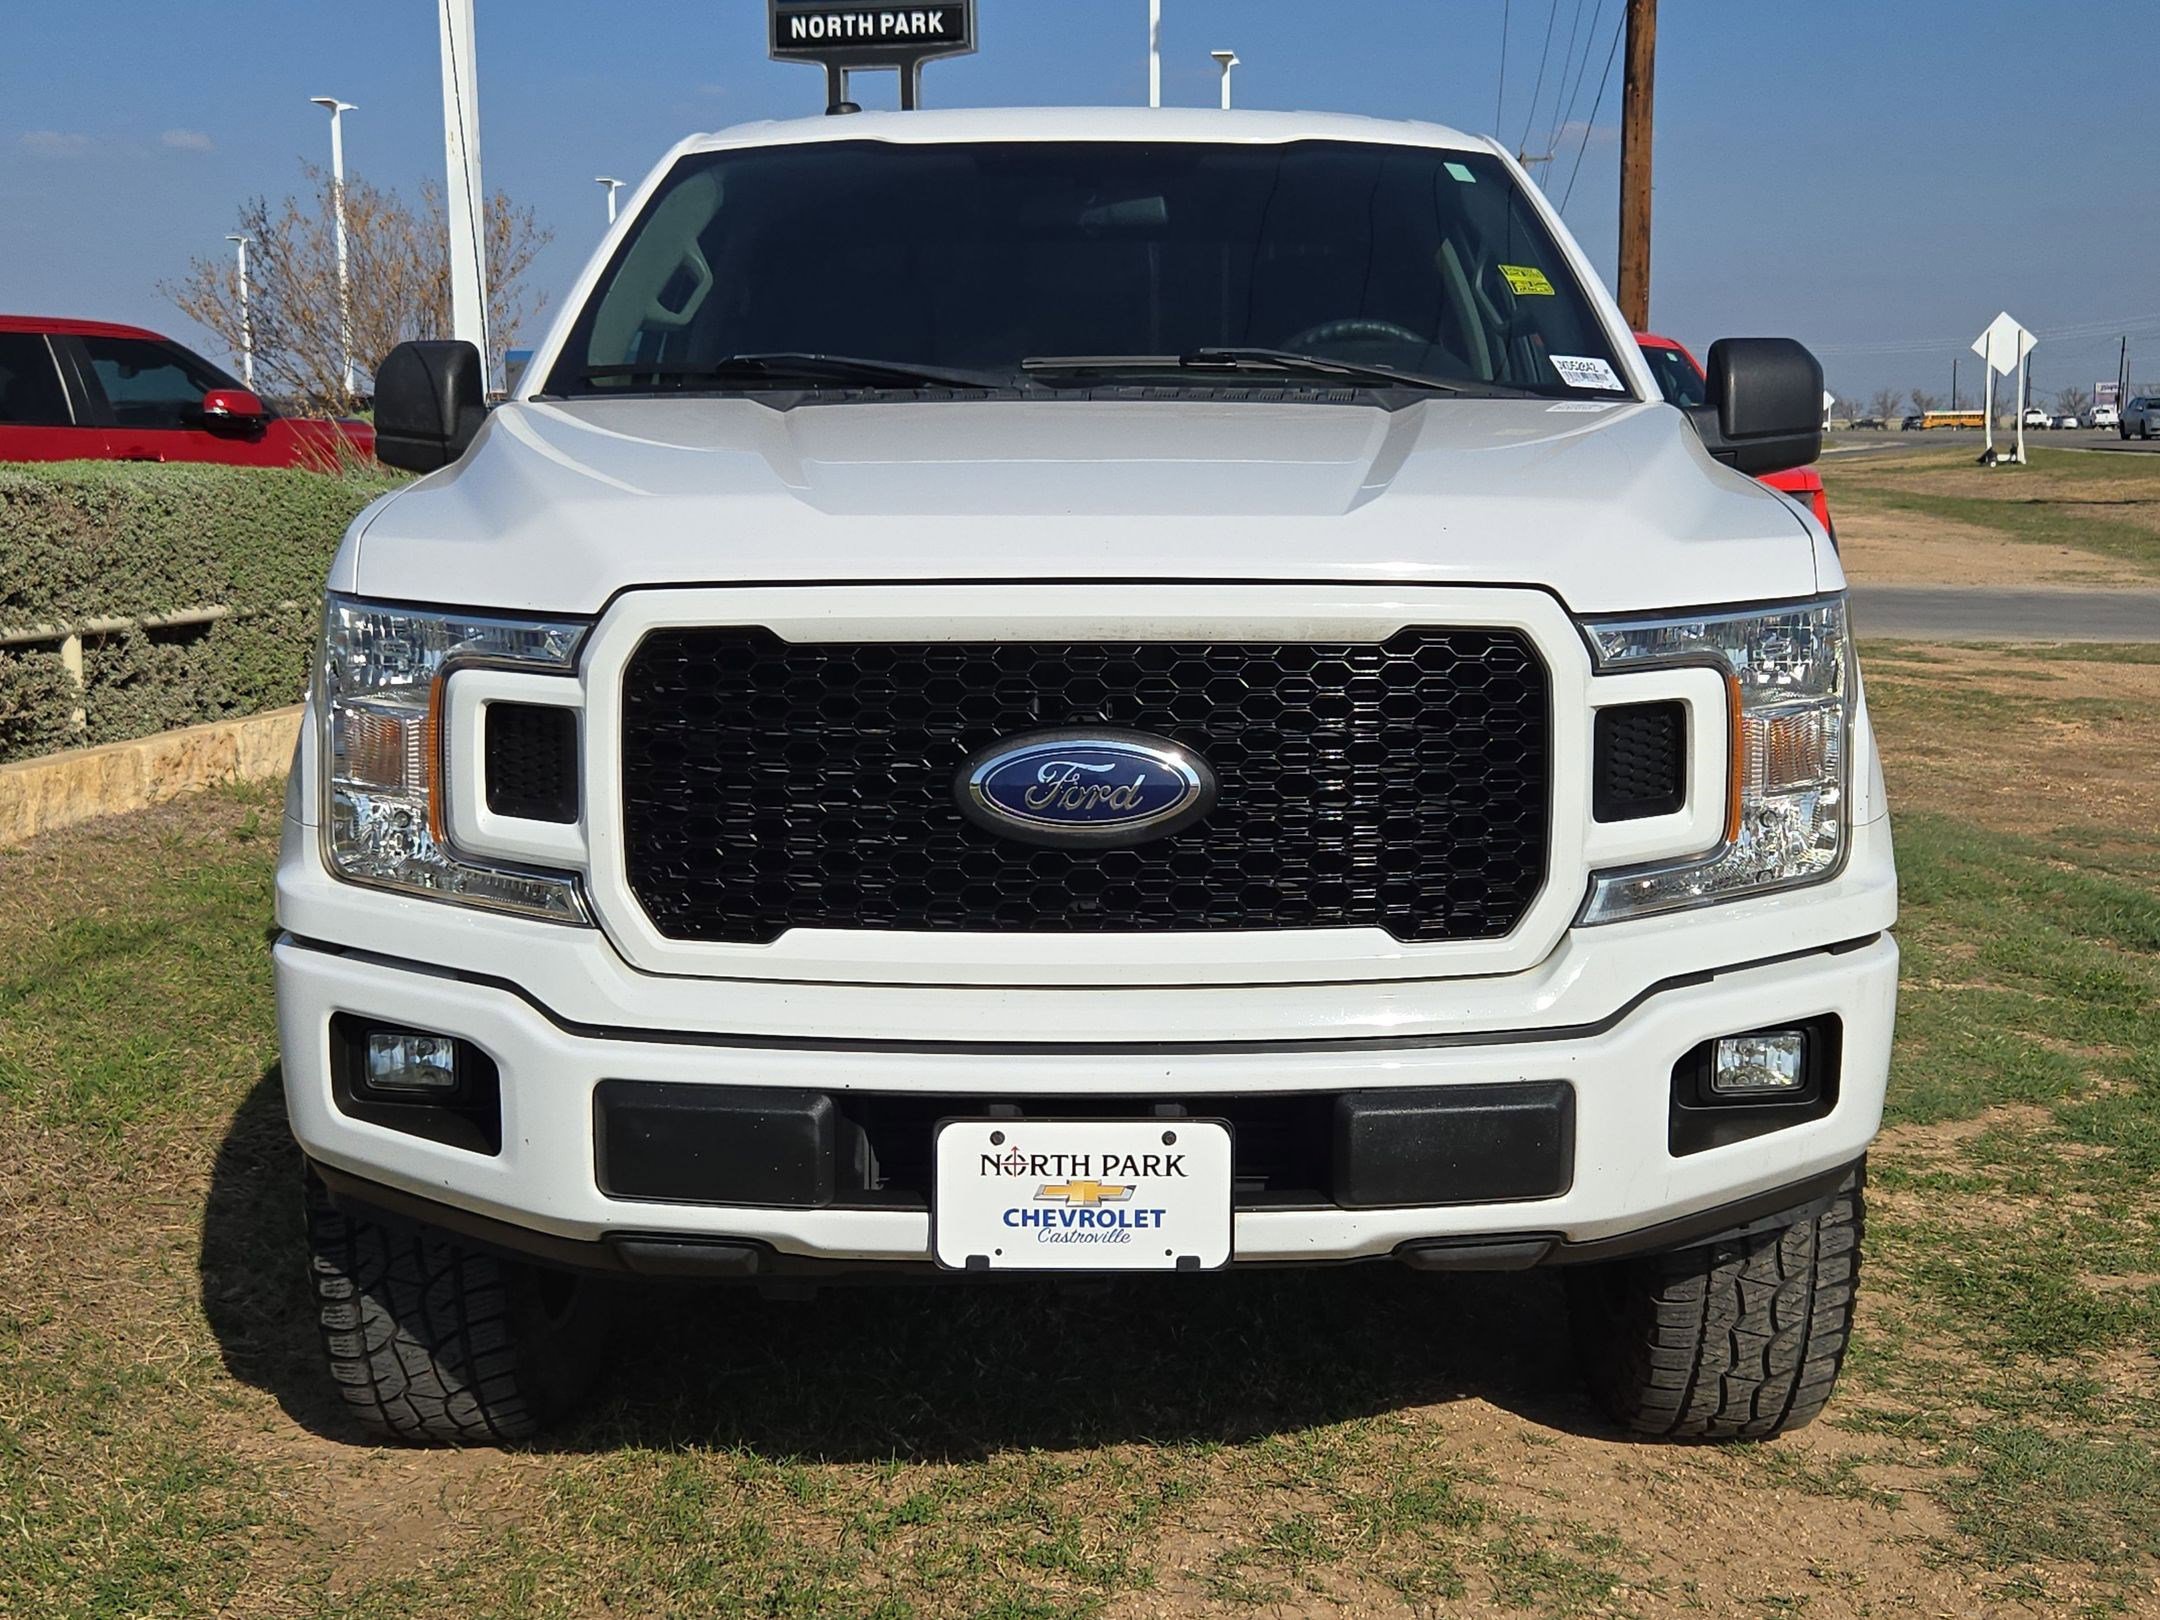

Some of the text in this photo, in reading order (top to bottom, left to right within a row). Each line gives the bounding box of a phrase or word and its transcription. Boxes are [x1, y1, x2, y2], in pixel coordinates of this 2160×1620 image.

[791, 11, 944, 39] NORTH PARK
[1025, 761, 1146, 810] Ford
[980, 1150, 1189, 1178] NORTH PARK
[1003, 1208, 1166, 1228] CHEVROLET
[1037, 1227, 1132, 1244] Castroville
